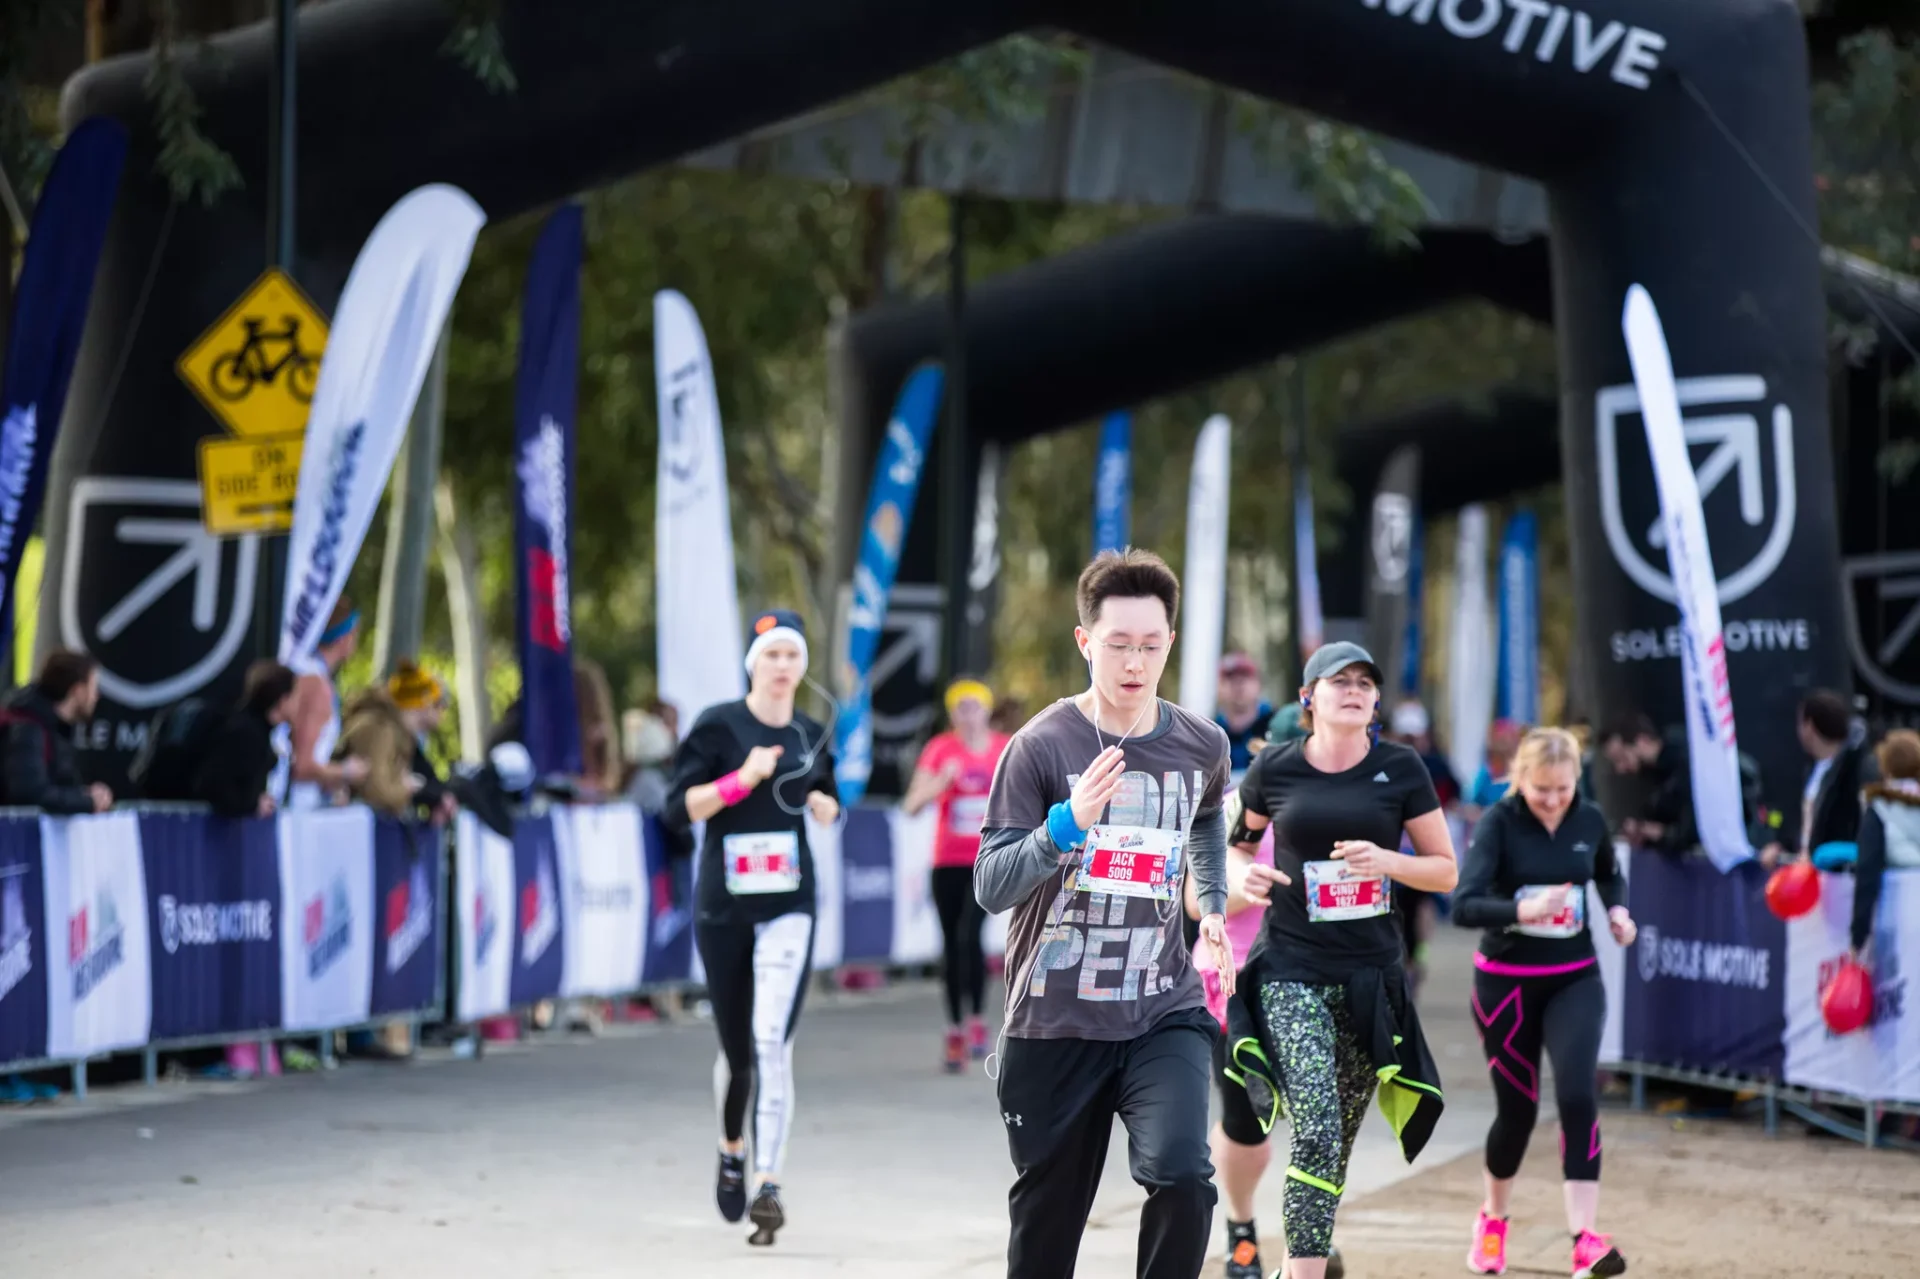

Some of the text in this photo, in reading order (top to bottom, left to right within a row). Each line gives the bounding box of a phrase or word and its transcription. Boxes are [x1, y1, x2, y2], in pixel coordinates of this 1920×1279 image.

[1724, 617, 1809, 652] OTIVE
[1109, 852, 1136, 867] JACK
[1108, 867, 1133, 880] 5009
[1329, 882, 1360, 896] CINDY
